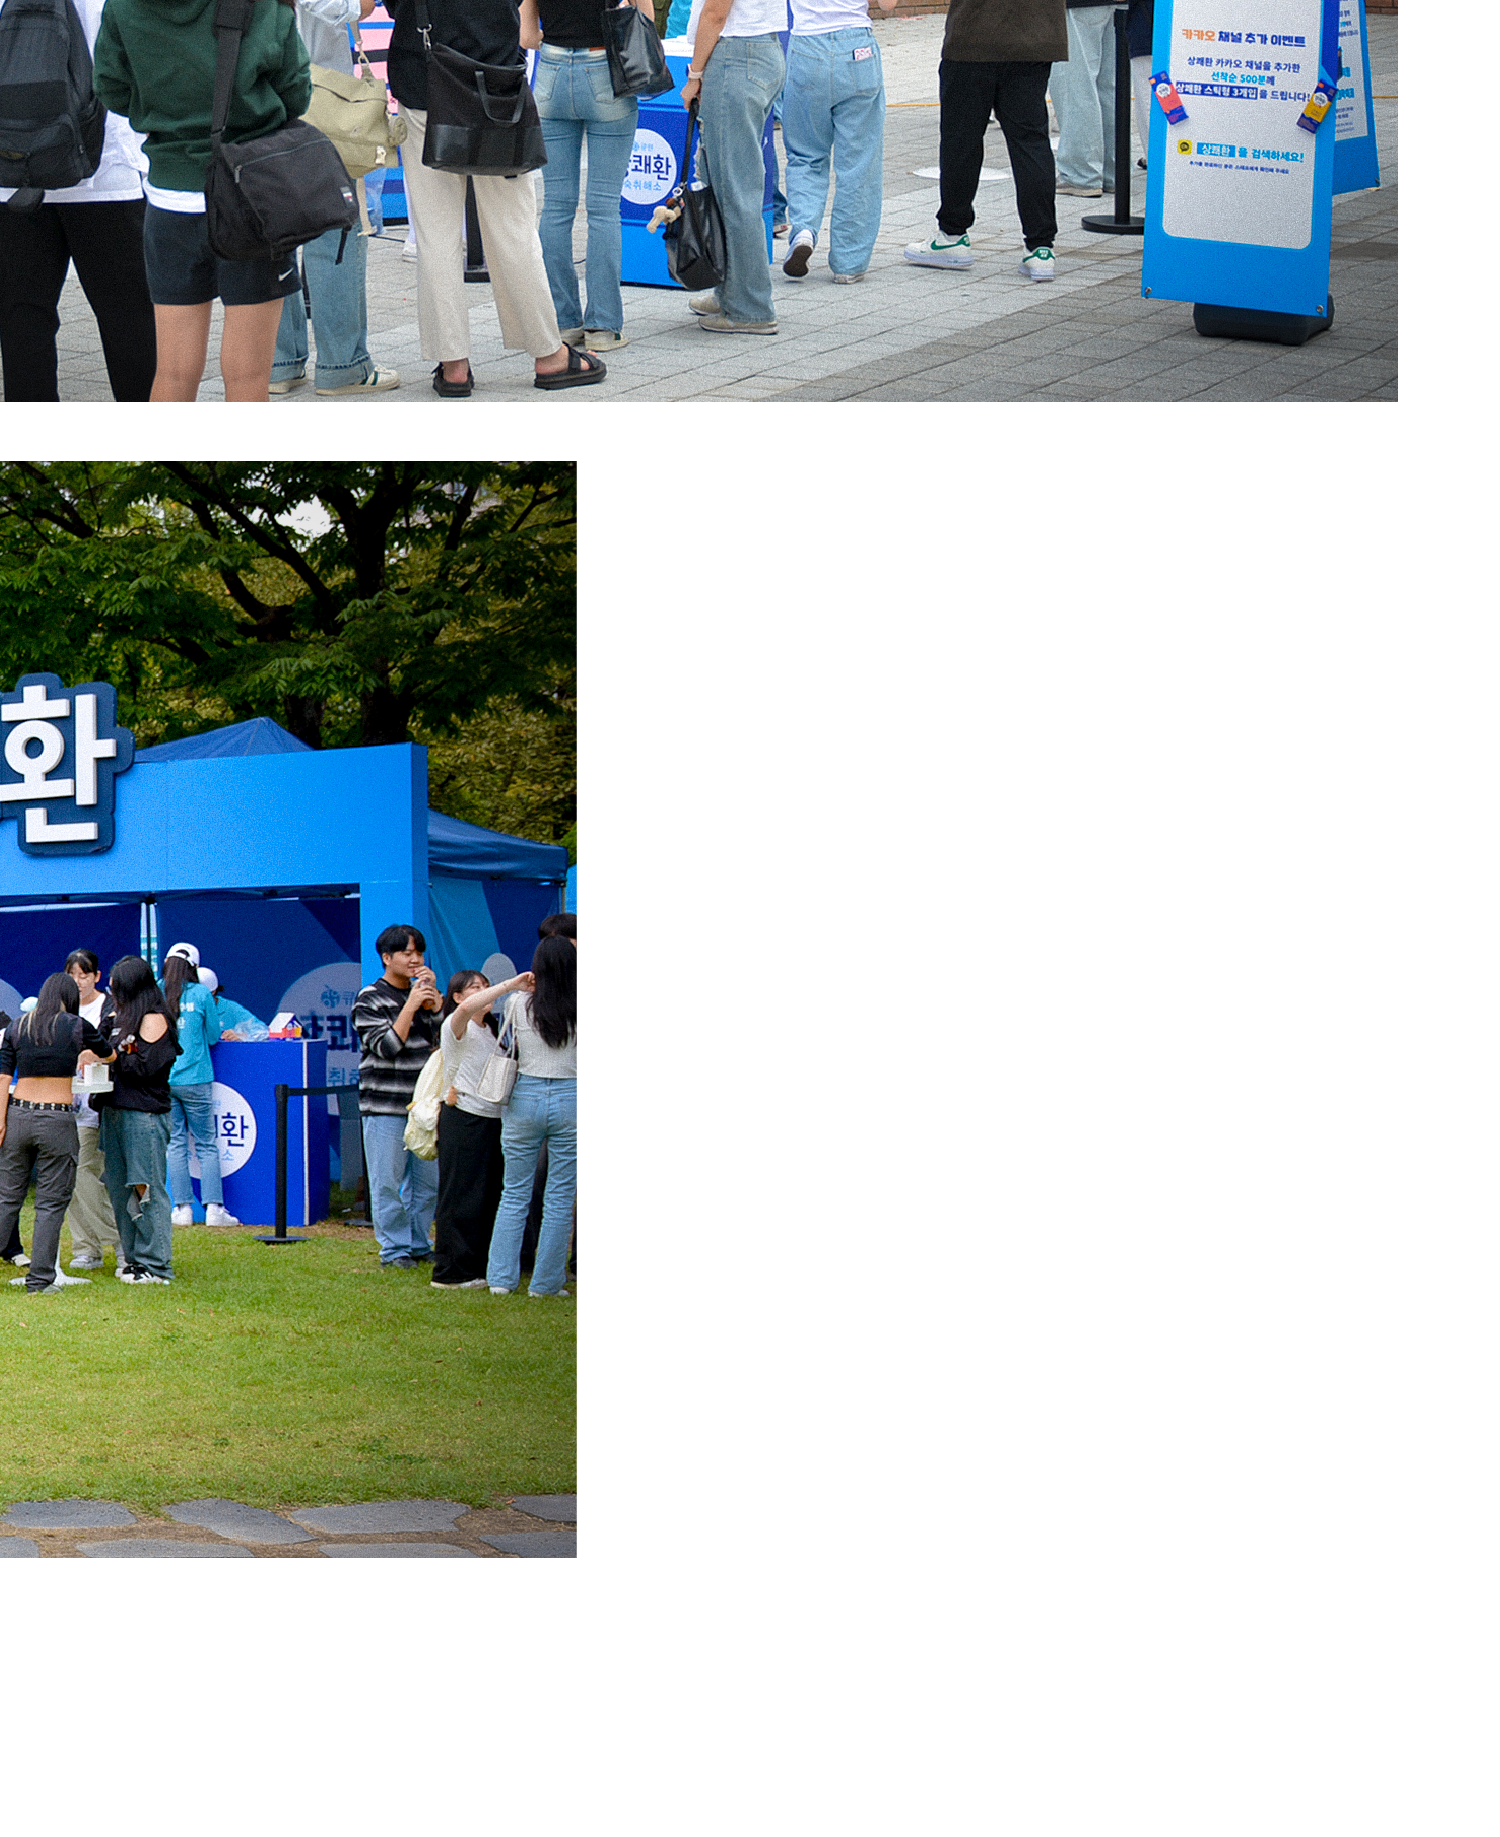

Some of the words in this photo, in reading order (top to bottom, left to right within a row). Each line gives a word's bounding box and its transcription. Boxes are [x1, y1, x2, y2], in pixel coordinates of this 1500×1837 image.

[1181, 28, 1216, 42] 카카오
[1218, 30, 1243, 44] 채널
[1245, 32, 1268, 46] 추가
[1271, 34, 1306, 47] 이벤트
[1216, 58, 1242, 69] 카카오
[1274, 62, 1301, 73] 추가한
[1252, 148, 1305, 163] 검색하세요!
[628, 154, 672, 181] 쾌환
